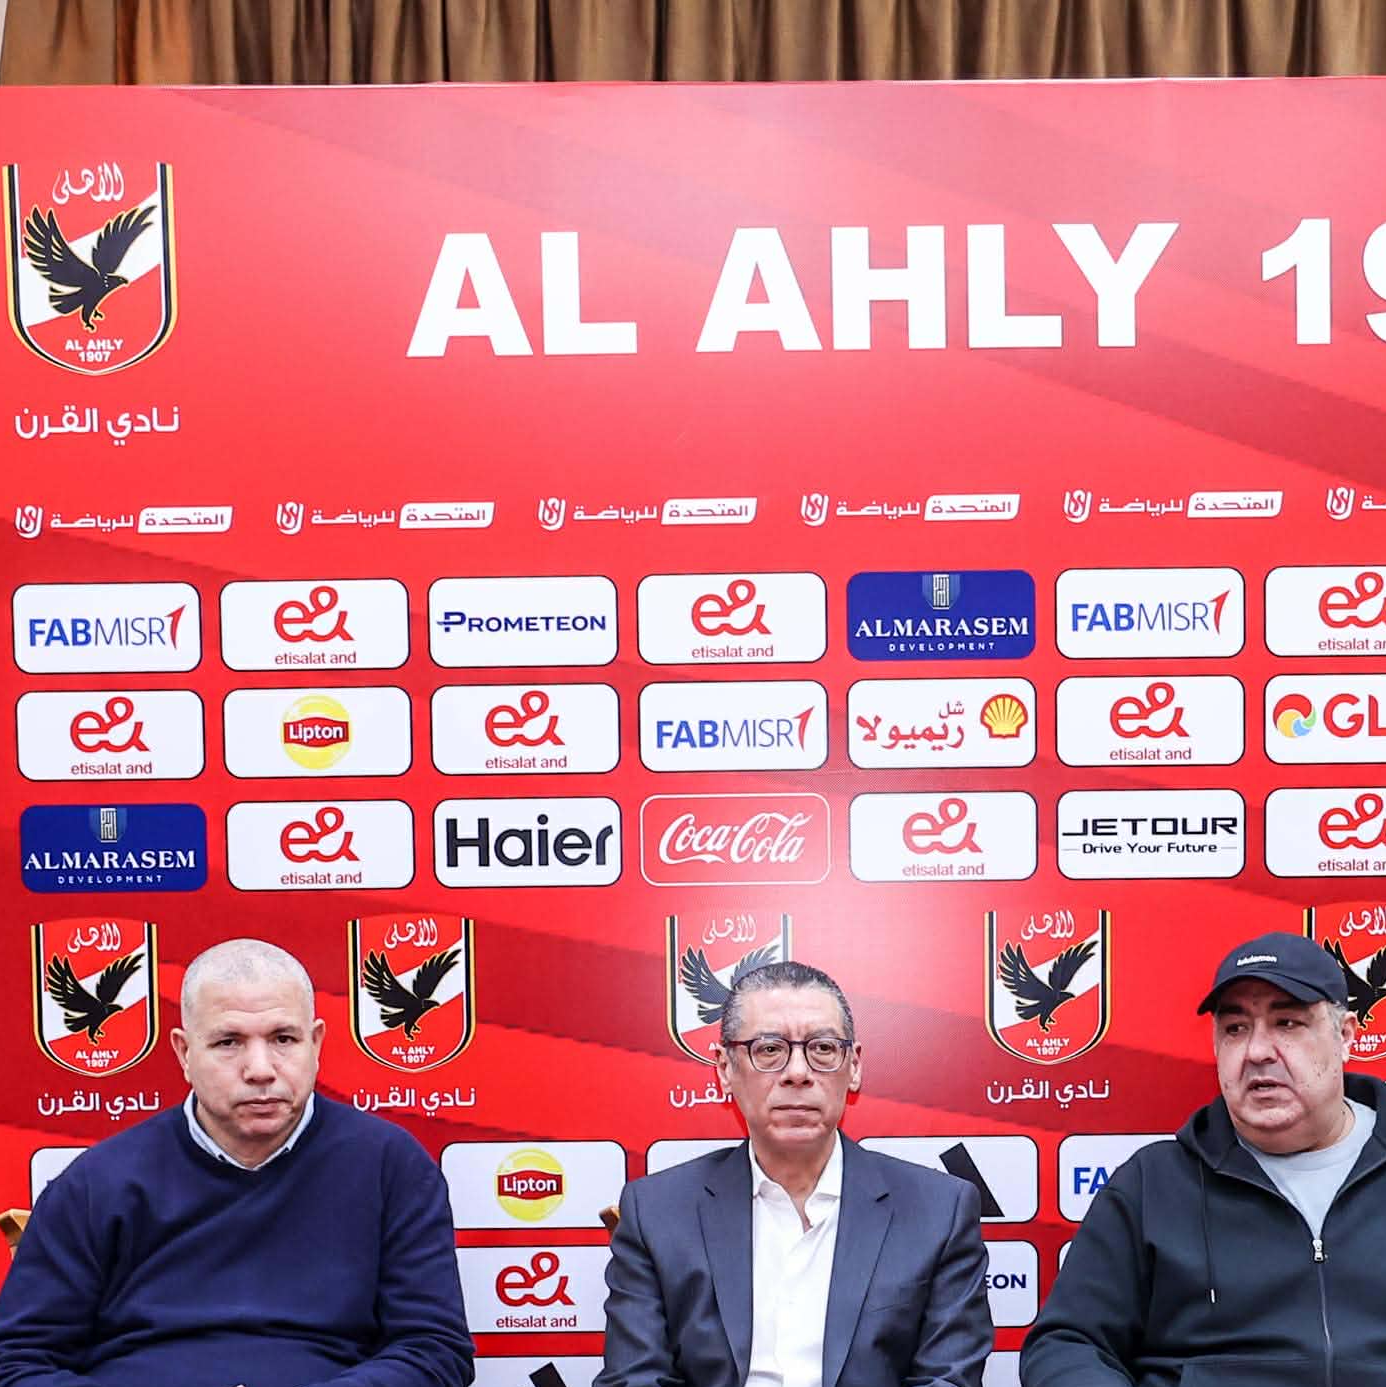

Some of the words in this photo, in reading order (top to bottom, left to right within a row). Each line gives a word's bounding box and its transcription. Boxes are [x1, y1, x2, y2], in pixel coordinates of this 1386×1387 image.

[408, 232, 637, 356] AL
[696, 223, 1178, 352] AHLY
[65, 340, 83, 350] AL
[87, 339, 123, 350] AHLY
[79, 351, 110, 362] 1907
[16, 406, 98, 438] القرن
[107, 407, 178, 445] نادي
[669, 504, 748, 517] المتحدة
[837, 501, 920, 519] للرياضة
[932, 500, 1011, 513] المتحدة
[1099, 498, 1183, 516] للرياضة
[1195, 498, 1273, 510] المتحدة
[145, 513, 223, 526] المتحدة
[312, 510, 395, 527] للرياضة
[406, 508, 485, 521] المتحدة
[574, 506, 657, 523] للرياضة
[51, 514, 133, 532] للرياضة
[856, 618, 1028, 637] ALMARASEM
[889, 643, 994, 651] DEVELOPMENT
[1318, 638, 1369, 650] etisalat
[275, 652, 326, 664] etisalat
[330, 652, 356, 664] and
[692, 646, 742, 658] etisalat
[747, 645, 773, 657] and
[939, 702, 964, 719] شل
[289, 723, 344, 743] Lipton
[857, 713, 964, 751] ريميولا
[1110, 748, 1160, 760] etisalat
[1165, 747, 1191, 760] and
[71, 763, 121, 775] etisalat
[126, 762, 152, 774] and
[485, 757, 536, 768] etisalat
[541, 756, 567, 768] and
[1062, 817, 1237, 836] JETOUR
[446, 814, 616, 869] Haier
[660, 813, 813, 864] Coca-Cola
[1083, 843, 1122, 853] Drive
[1127, 843, 1162, 854] Your
[1168, 842, 1217, 852] Future
[25, 851, 194, 869] ALMARASEM
[1318, 859, 1368, 871] etisalat
[902, 864, 954, 876] etisalat
[958, 864, 984, 875] and
[58, 875, 161, 884] DEVELOPMENT
[281, 873, 331, 884] etisalat
[336, 872, 362, 883] and
[1027, 1039, 1044, 1048] AL
[1045, 1039, 1069, 1048] AHLY
[76, 1051, 89, 1059] AL
[93, 1051, 118, 1060] AHLY
[392, 1047, 409, 1055] AL
[1037, 1047, 1060, 1055] 1907
[86, 1058, 109, 1067] 1907
[402, 1055, 425, 1063] 1907
[988, 1079, 1049, 1103] القرن
[1056, 1080, 1109, 1108] نادي
[38, 1091, 99, 1115] القرن
[354, 1087, 415, 1111] القرن
[422, 1088, 475, 1116] نادي
[106, 1092, 159, 1120] نادي
[503, 1176, 557, 1195] Lipton
[496, 1316, 546, 1328] etisalat
[551, 1315, 576, 1327] and
